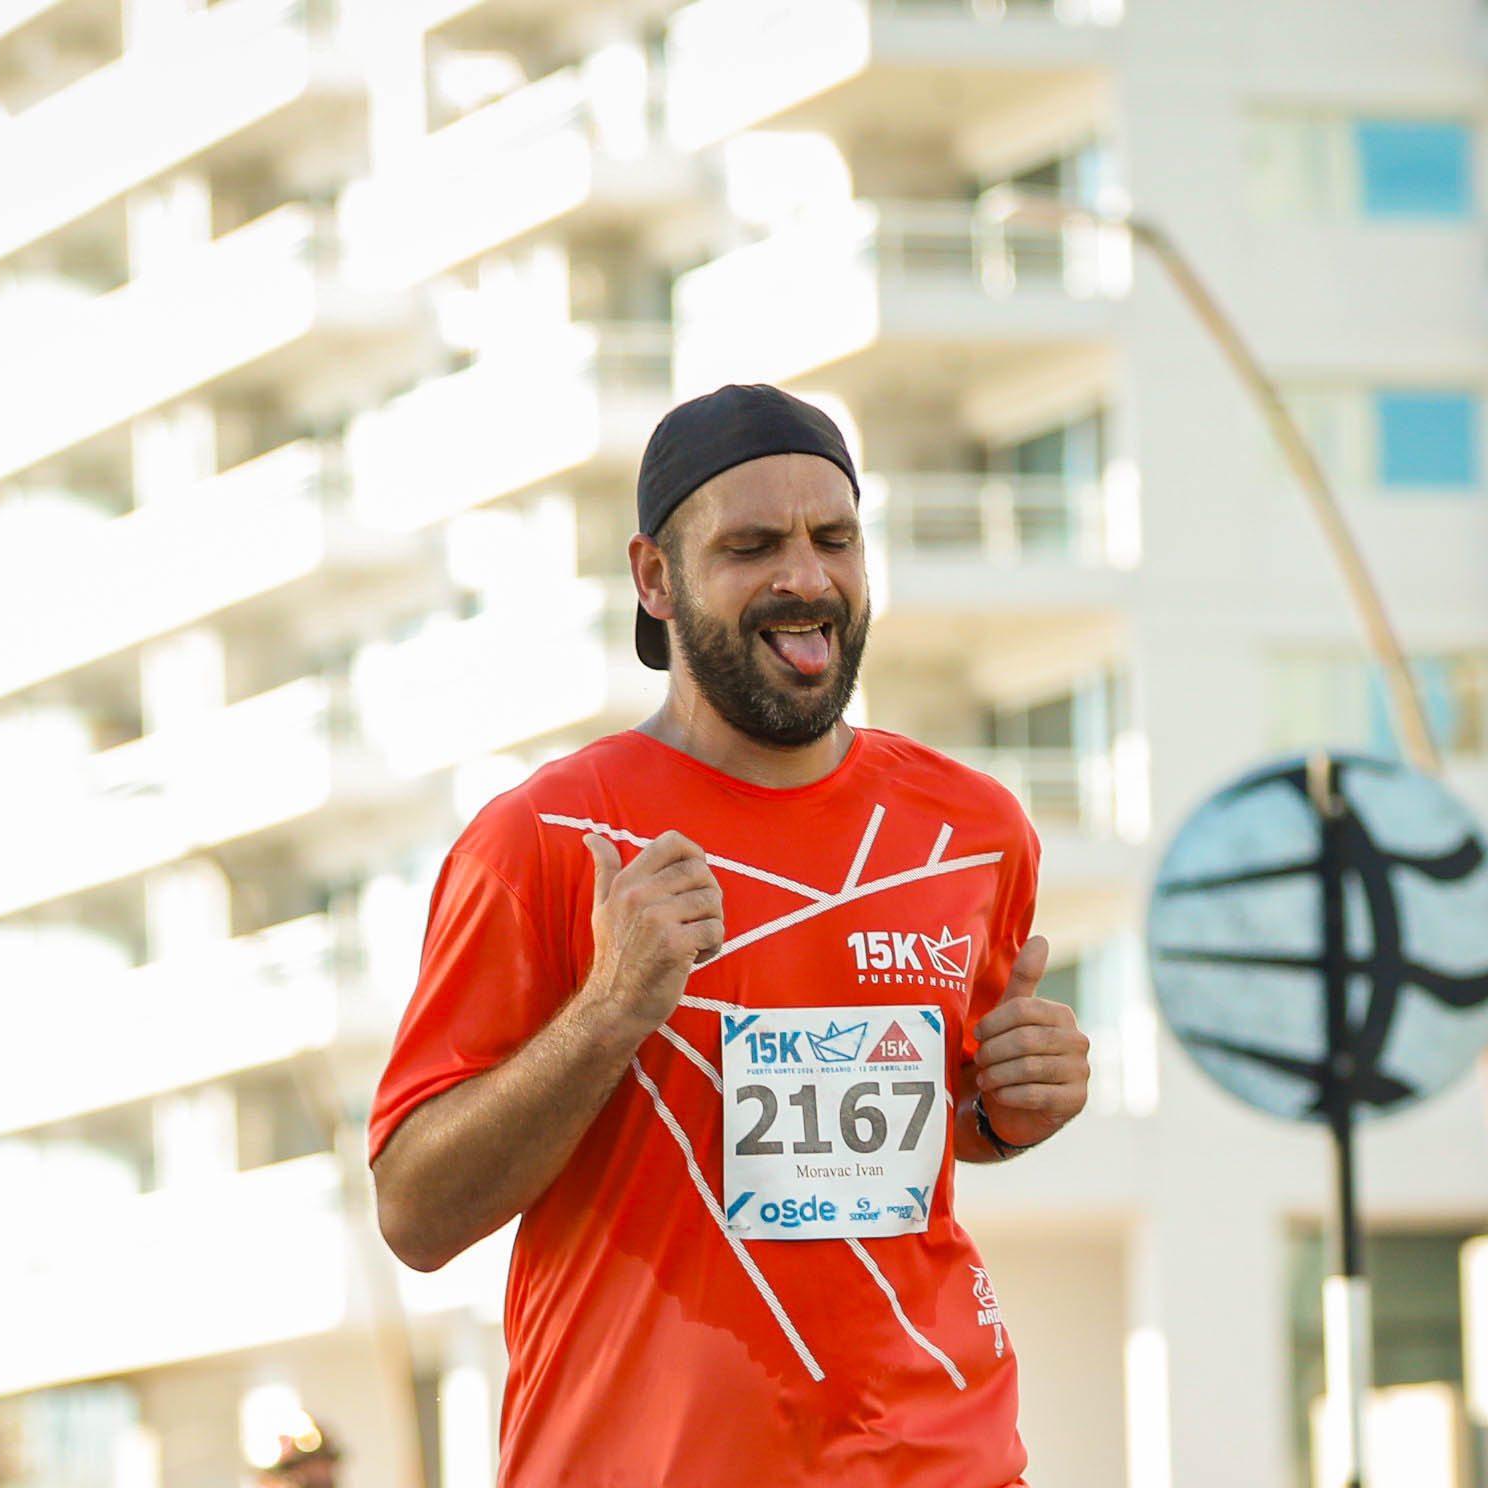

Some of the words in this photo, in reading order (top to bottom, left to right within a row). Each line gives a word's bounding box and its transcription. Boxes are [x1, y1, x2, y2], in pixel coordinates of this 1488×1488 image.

[847, 931, 924, 971] 15K
[858, 974, 925, 985] PUERTO
[930, 977, 967, 993] NORTE
[745, 1031, 803, 1064] 15K
[879, 1039, 912, 1058] 15K
[881, 1064, 901, 1072] ABRIL
[735, 1081, 936, 1156] 2167
[796, 1164, 852, 1179] Moravac
[855, 1163, 885, 1177] Ivan
[759, 1195, 836, 1224] osde
